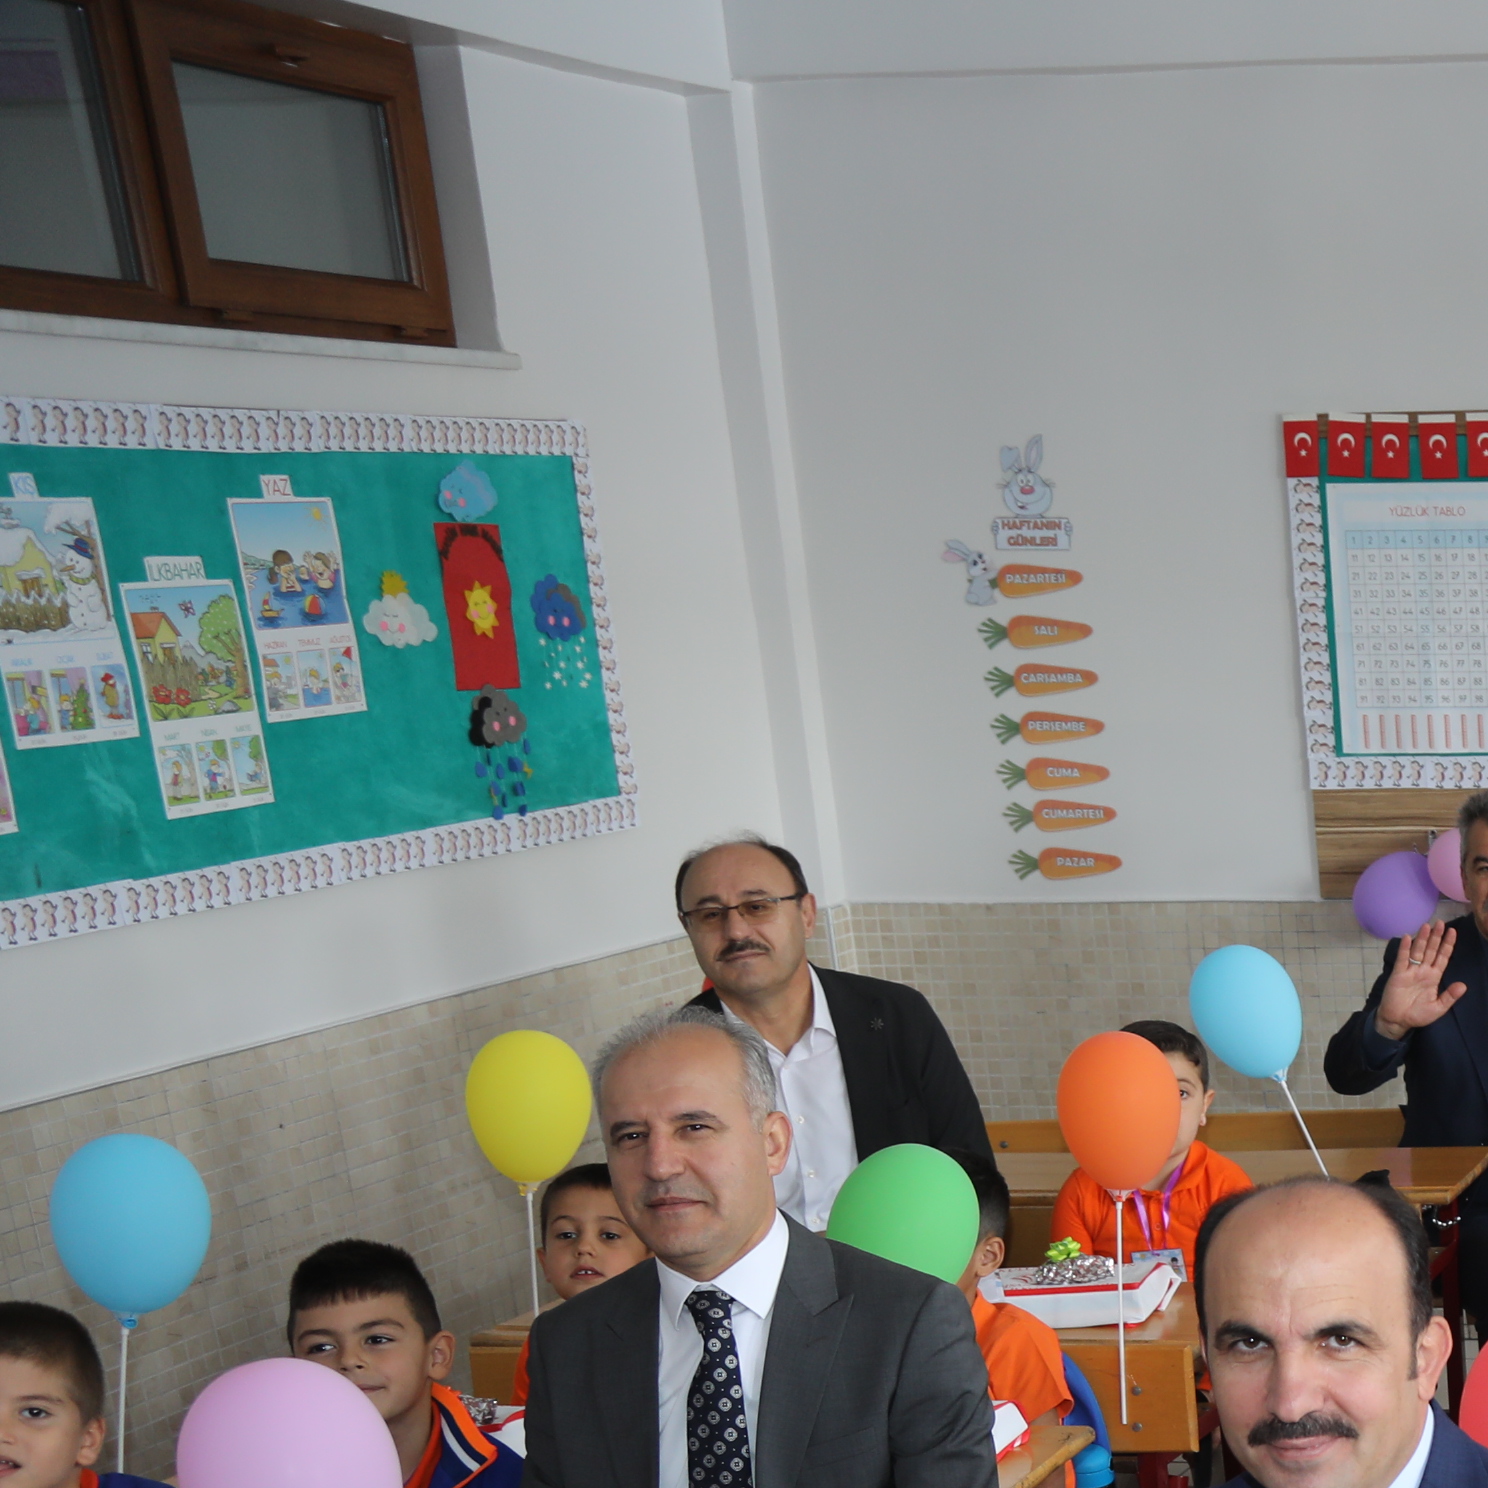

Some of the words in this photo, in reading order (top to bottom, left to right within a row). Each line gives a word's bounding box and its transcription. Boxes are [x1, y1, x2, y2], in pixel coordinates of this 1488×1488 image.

[14, 475, 36, 495] KIŞ
[262, 478, 291, 496] YAZ
[1389, 505, 1429, 517] YÜZLÜK
[1433, 505, 1466, 516] TABLO
[1001, 520, 1062, 530] HAFTANIN
[1007, 534, 1058, 546] GÜNLERİ
[148, 560, 204, 581] İLKBAHAR
[1005, 571, 1066, 583] PAZARTESİ
[1034, 626, 1058, 635] SALI
[1046, 767, 1081, 777] CUMA
[1041, 807, 1105, 818] CUMARTESİ
[1056, 857, 1096, 867] PAZAR
